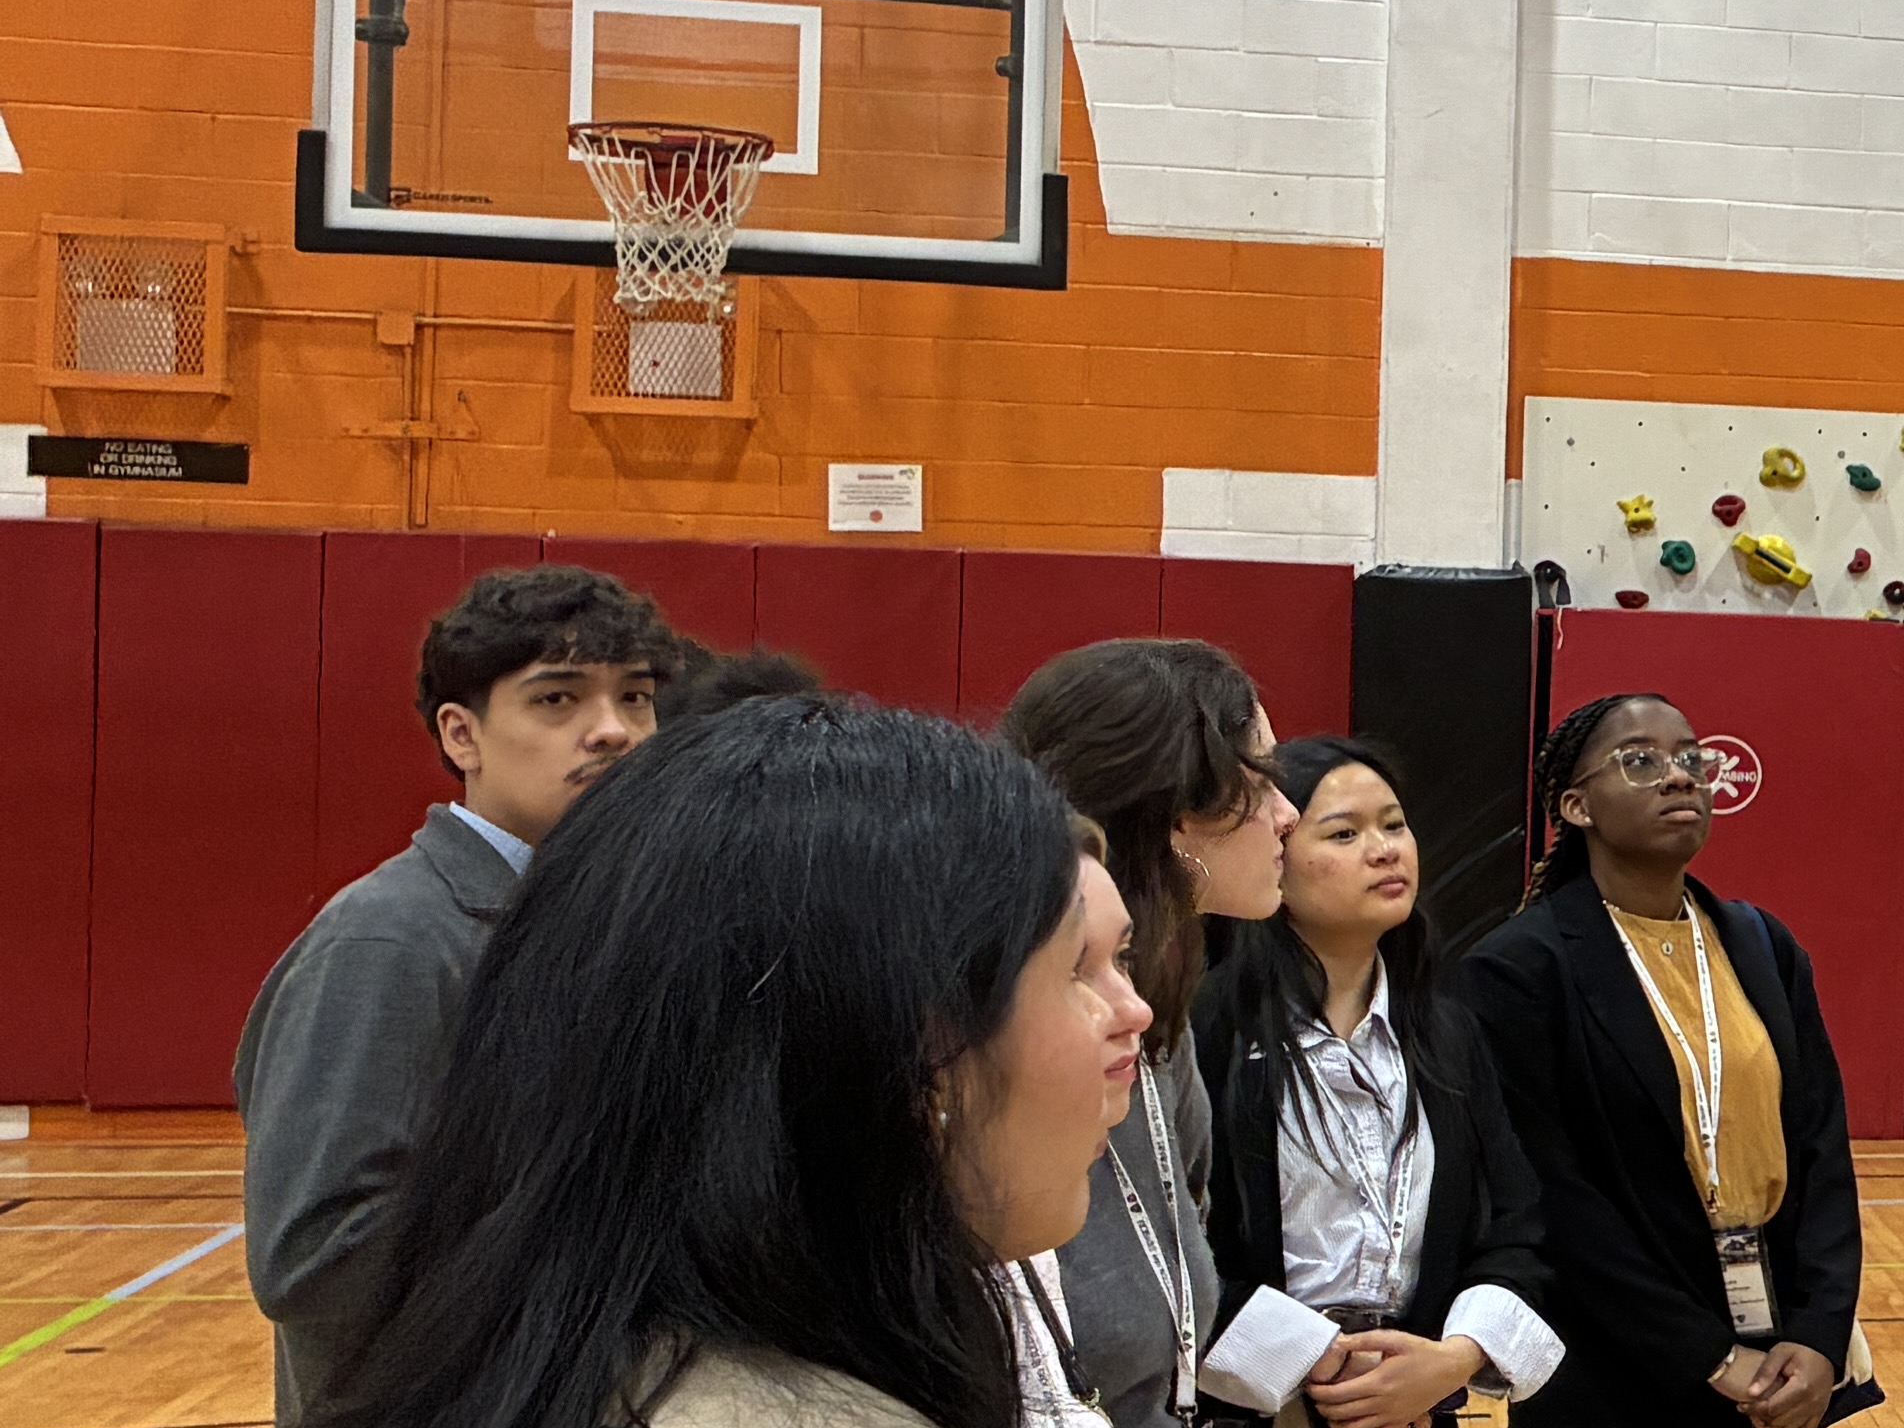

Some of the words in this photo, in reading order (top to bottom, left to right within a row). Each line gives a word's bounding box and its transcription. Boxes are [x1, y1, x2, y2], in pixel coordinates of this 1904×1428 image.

[104, 442, 124, 453] NO
[127, 442, 172, 454] EATING
[99, 453, 118, 463] OR
[121, 453, 177, 466] DRINKING
[108, 464, 183, 478] GYMNASIUM
